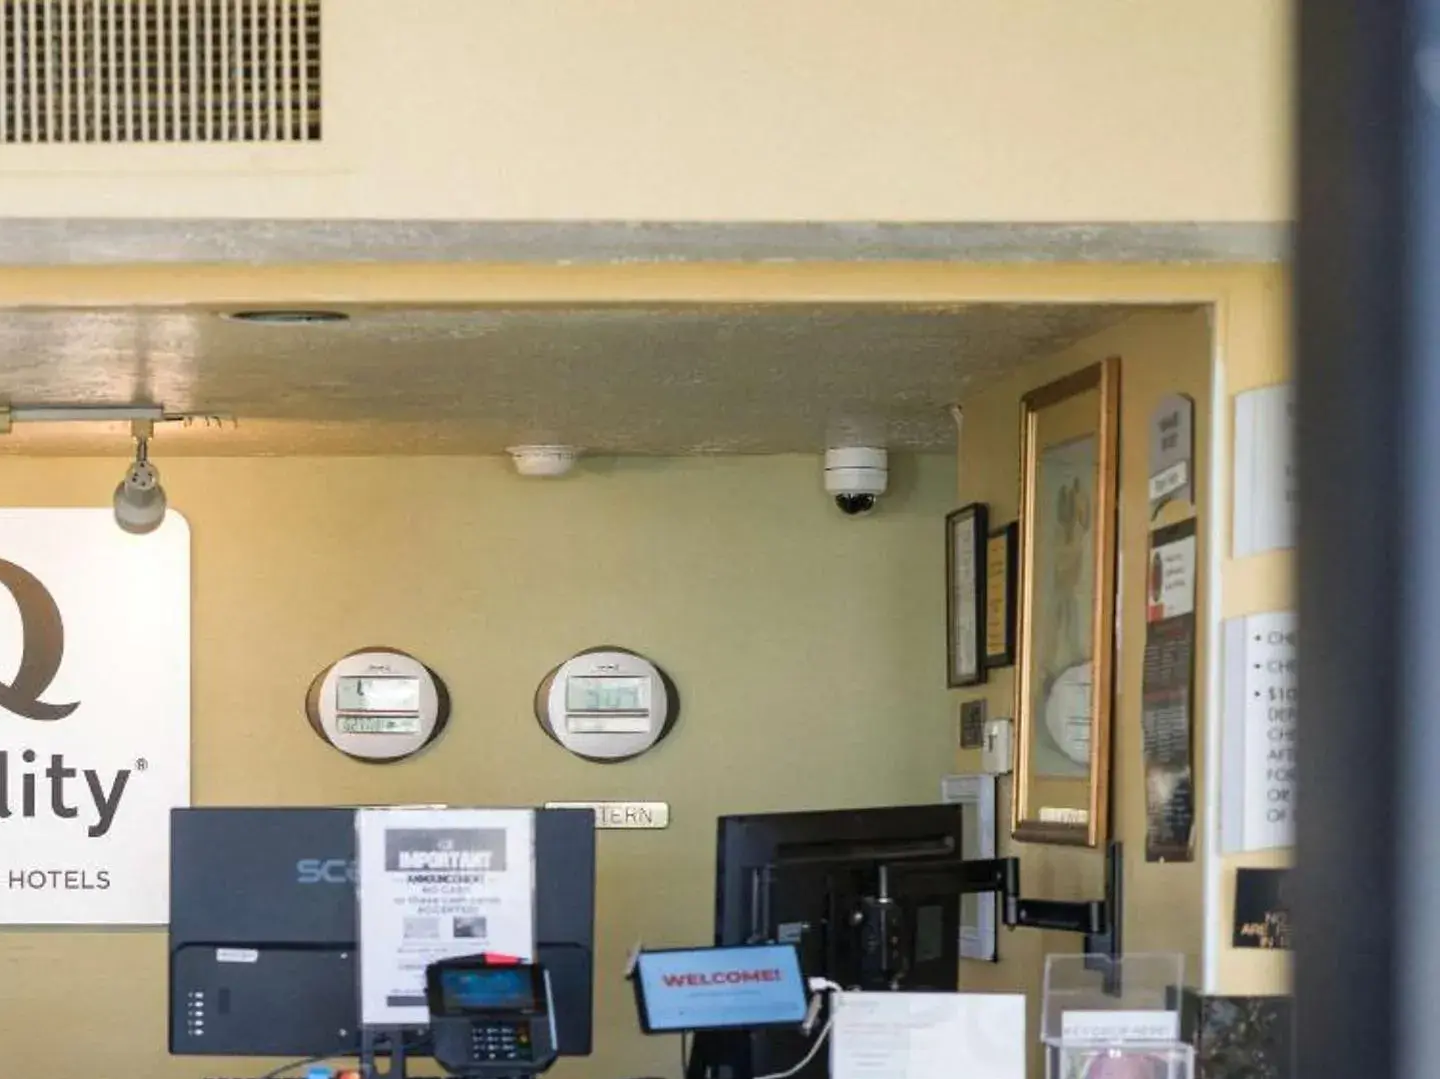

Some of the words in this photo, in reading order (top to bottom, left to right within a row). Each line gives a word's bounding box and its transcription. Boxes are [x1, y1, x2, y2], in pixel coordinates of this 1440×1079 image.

[599, 805, 653, 823] TERN
[9, 869, 111, 890] HOTELS
[663, 967, 782, 988] WELCOME!
